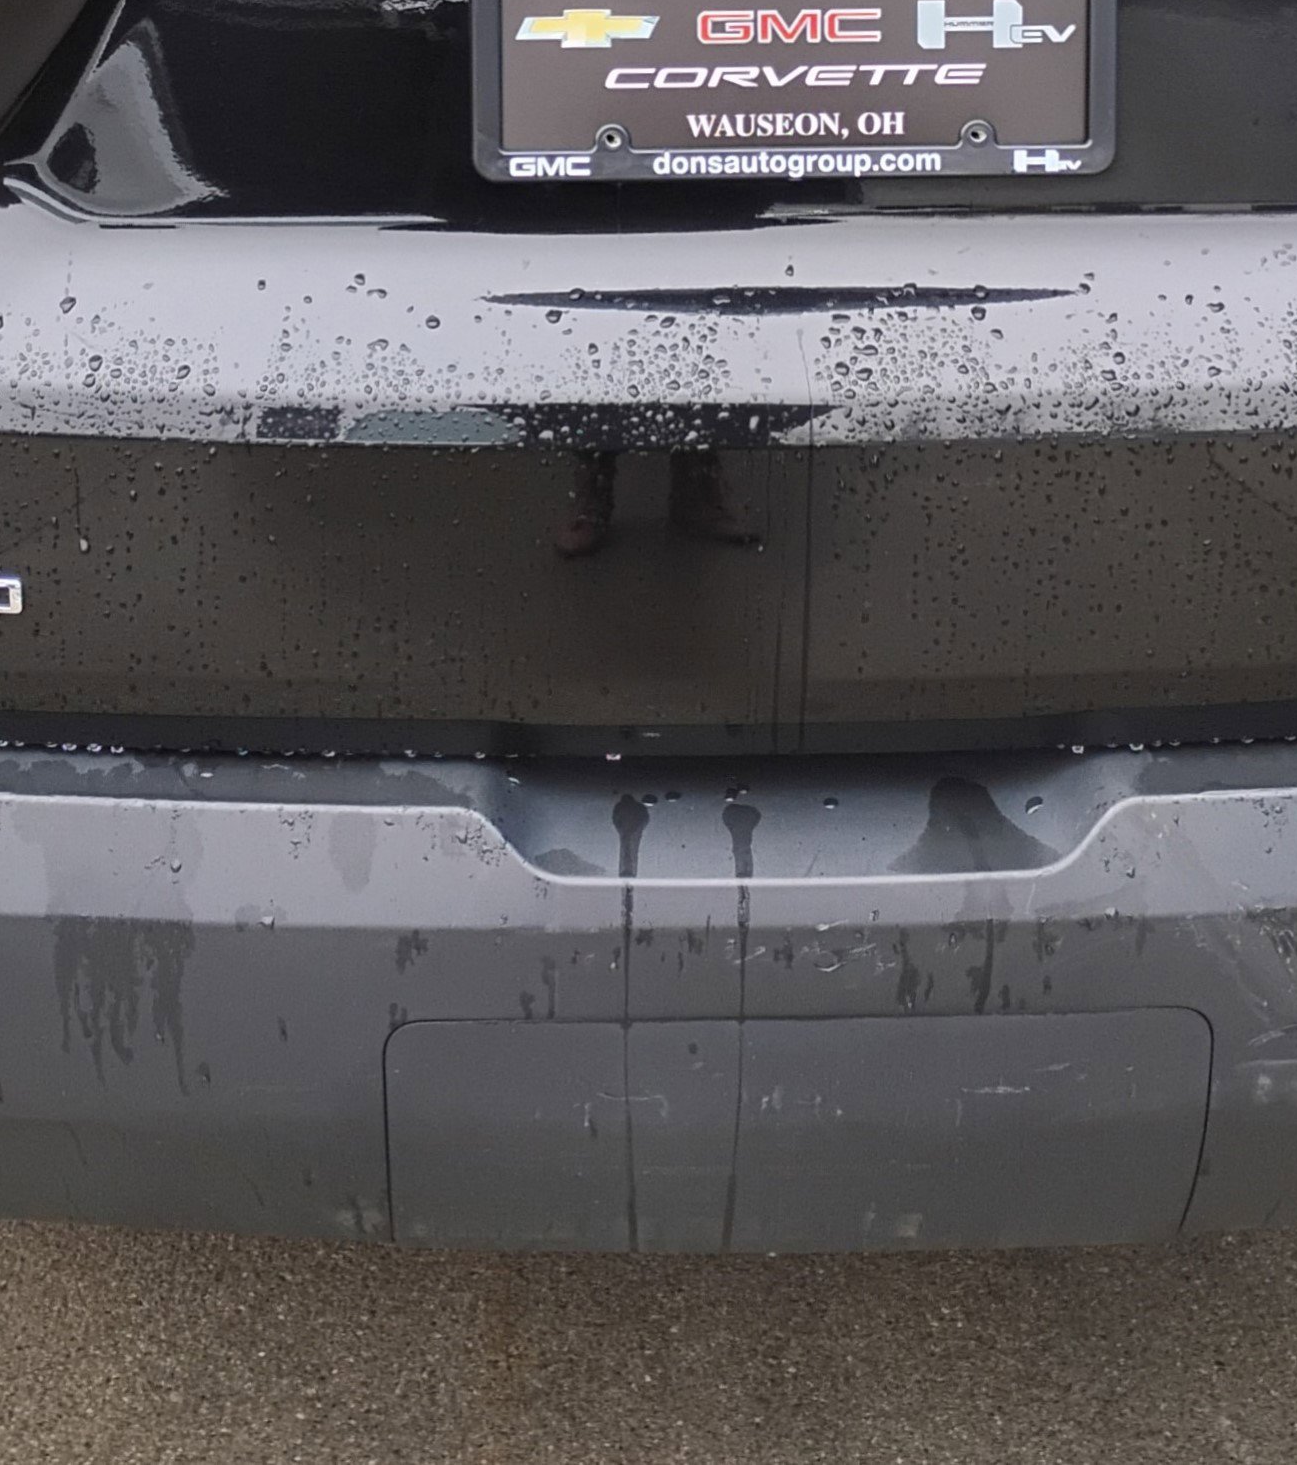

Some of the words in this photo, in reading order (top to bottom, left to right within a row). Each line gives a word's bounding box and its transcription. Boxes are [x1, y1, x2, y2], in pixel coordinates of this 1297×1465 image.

[696, 7, 883, 46] GMC
[604, 62, 988, 90] CORVETTE
[686, 112, 850, 140] WAUSEON,
[857, 111, 906, 136] OH
[508, 153, 592, 178] GMC
[652, 149, 943, 179] donsautogroup.com
